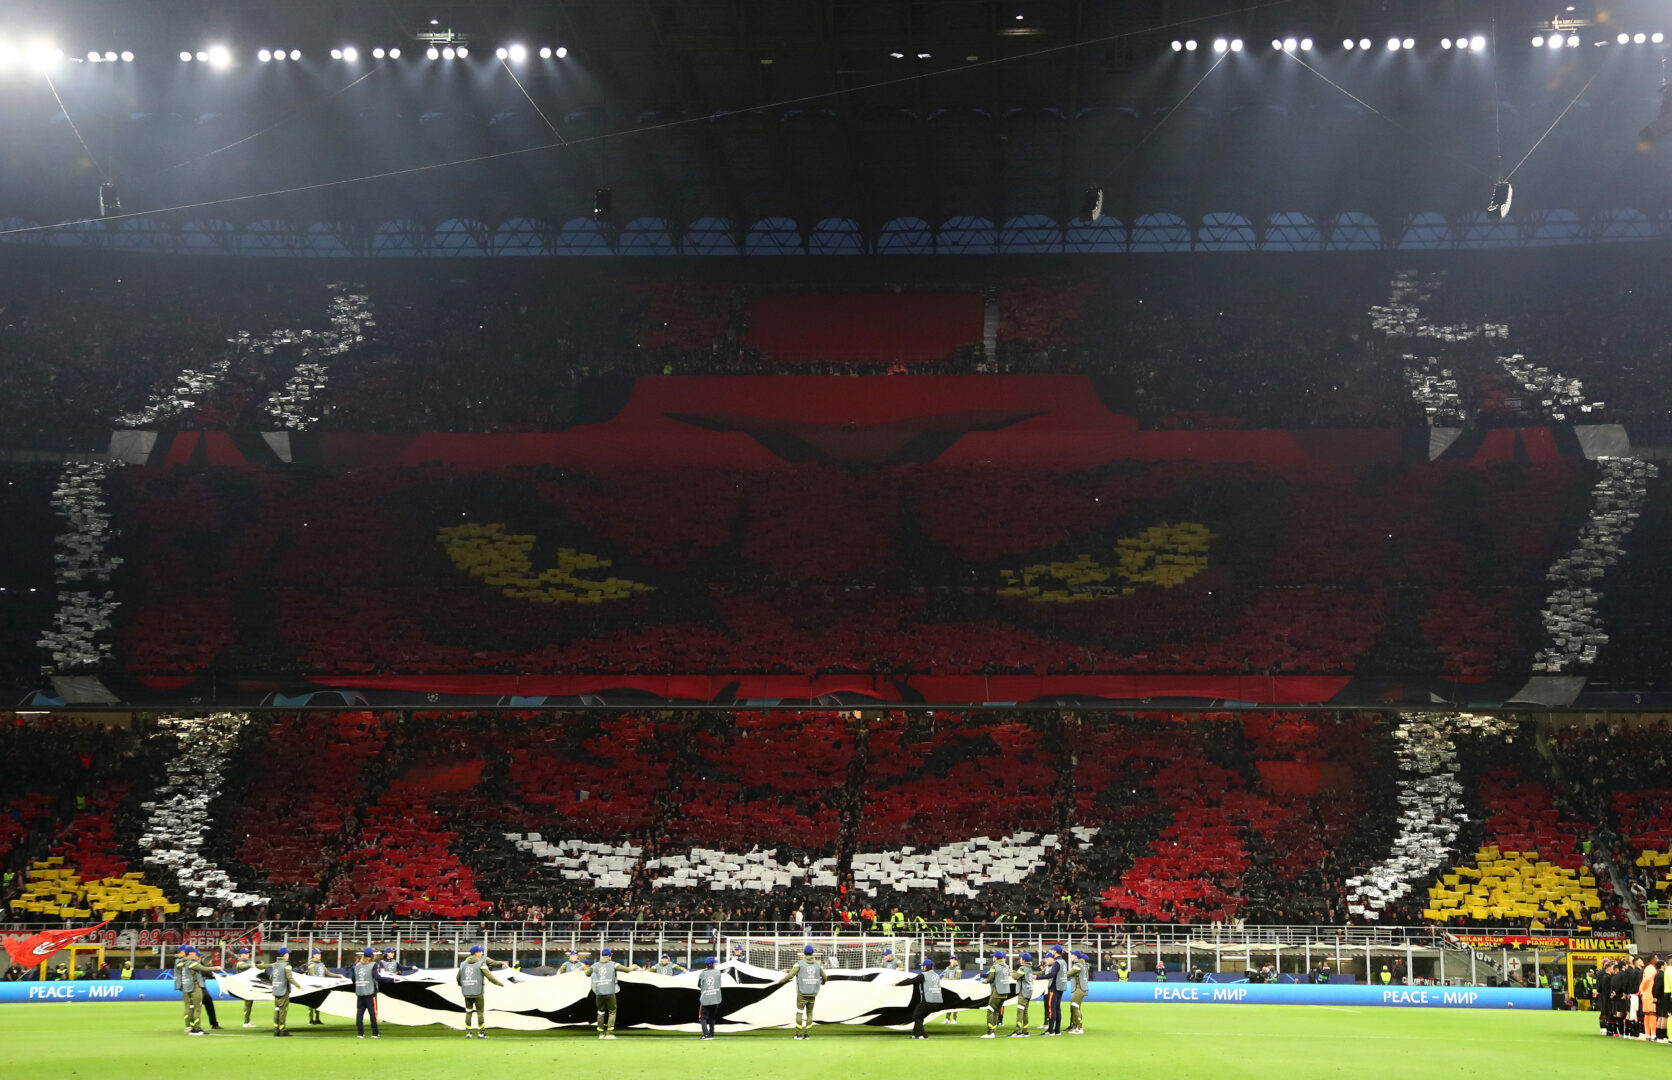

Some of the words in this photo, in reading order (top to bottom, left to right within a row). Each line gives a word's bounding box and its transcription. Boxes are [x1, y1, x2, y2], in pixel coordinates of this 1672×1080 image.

[29, 986, 75, 998] PEACE
[89, 986, 124, 998] МИР
[1154, 987, 1199, 1000] PEACE
[1213, 988, 1247, 1001] МИР
[1383, 991, 1428, 1003] PEACE
[1443, 991, 1478, 1004] МИР
